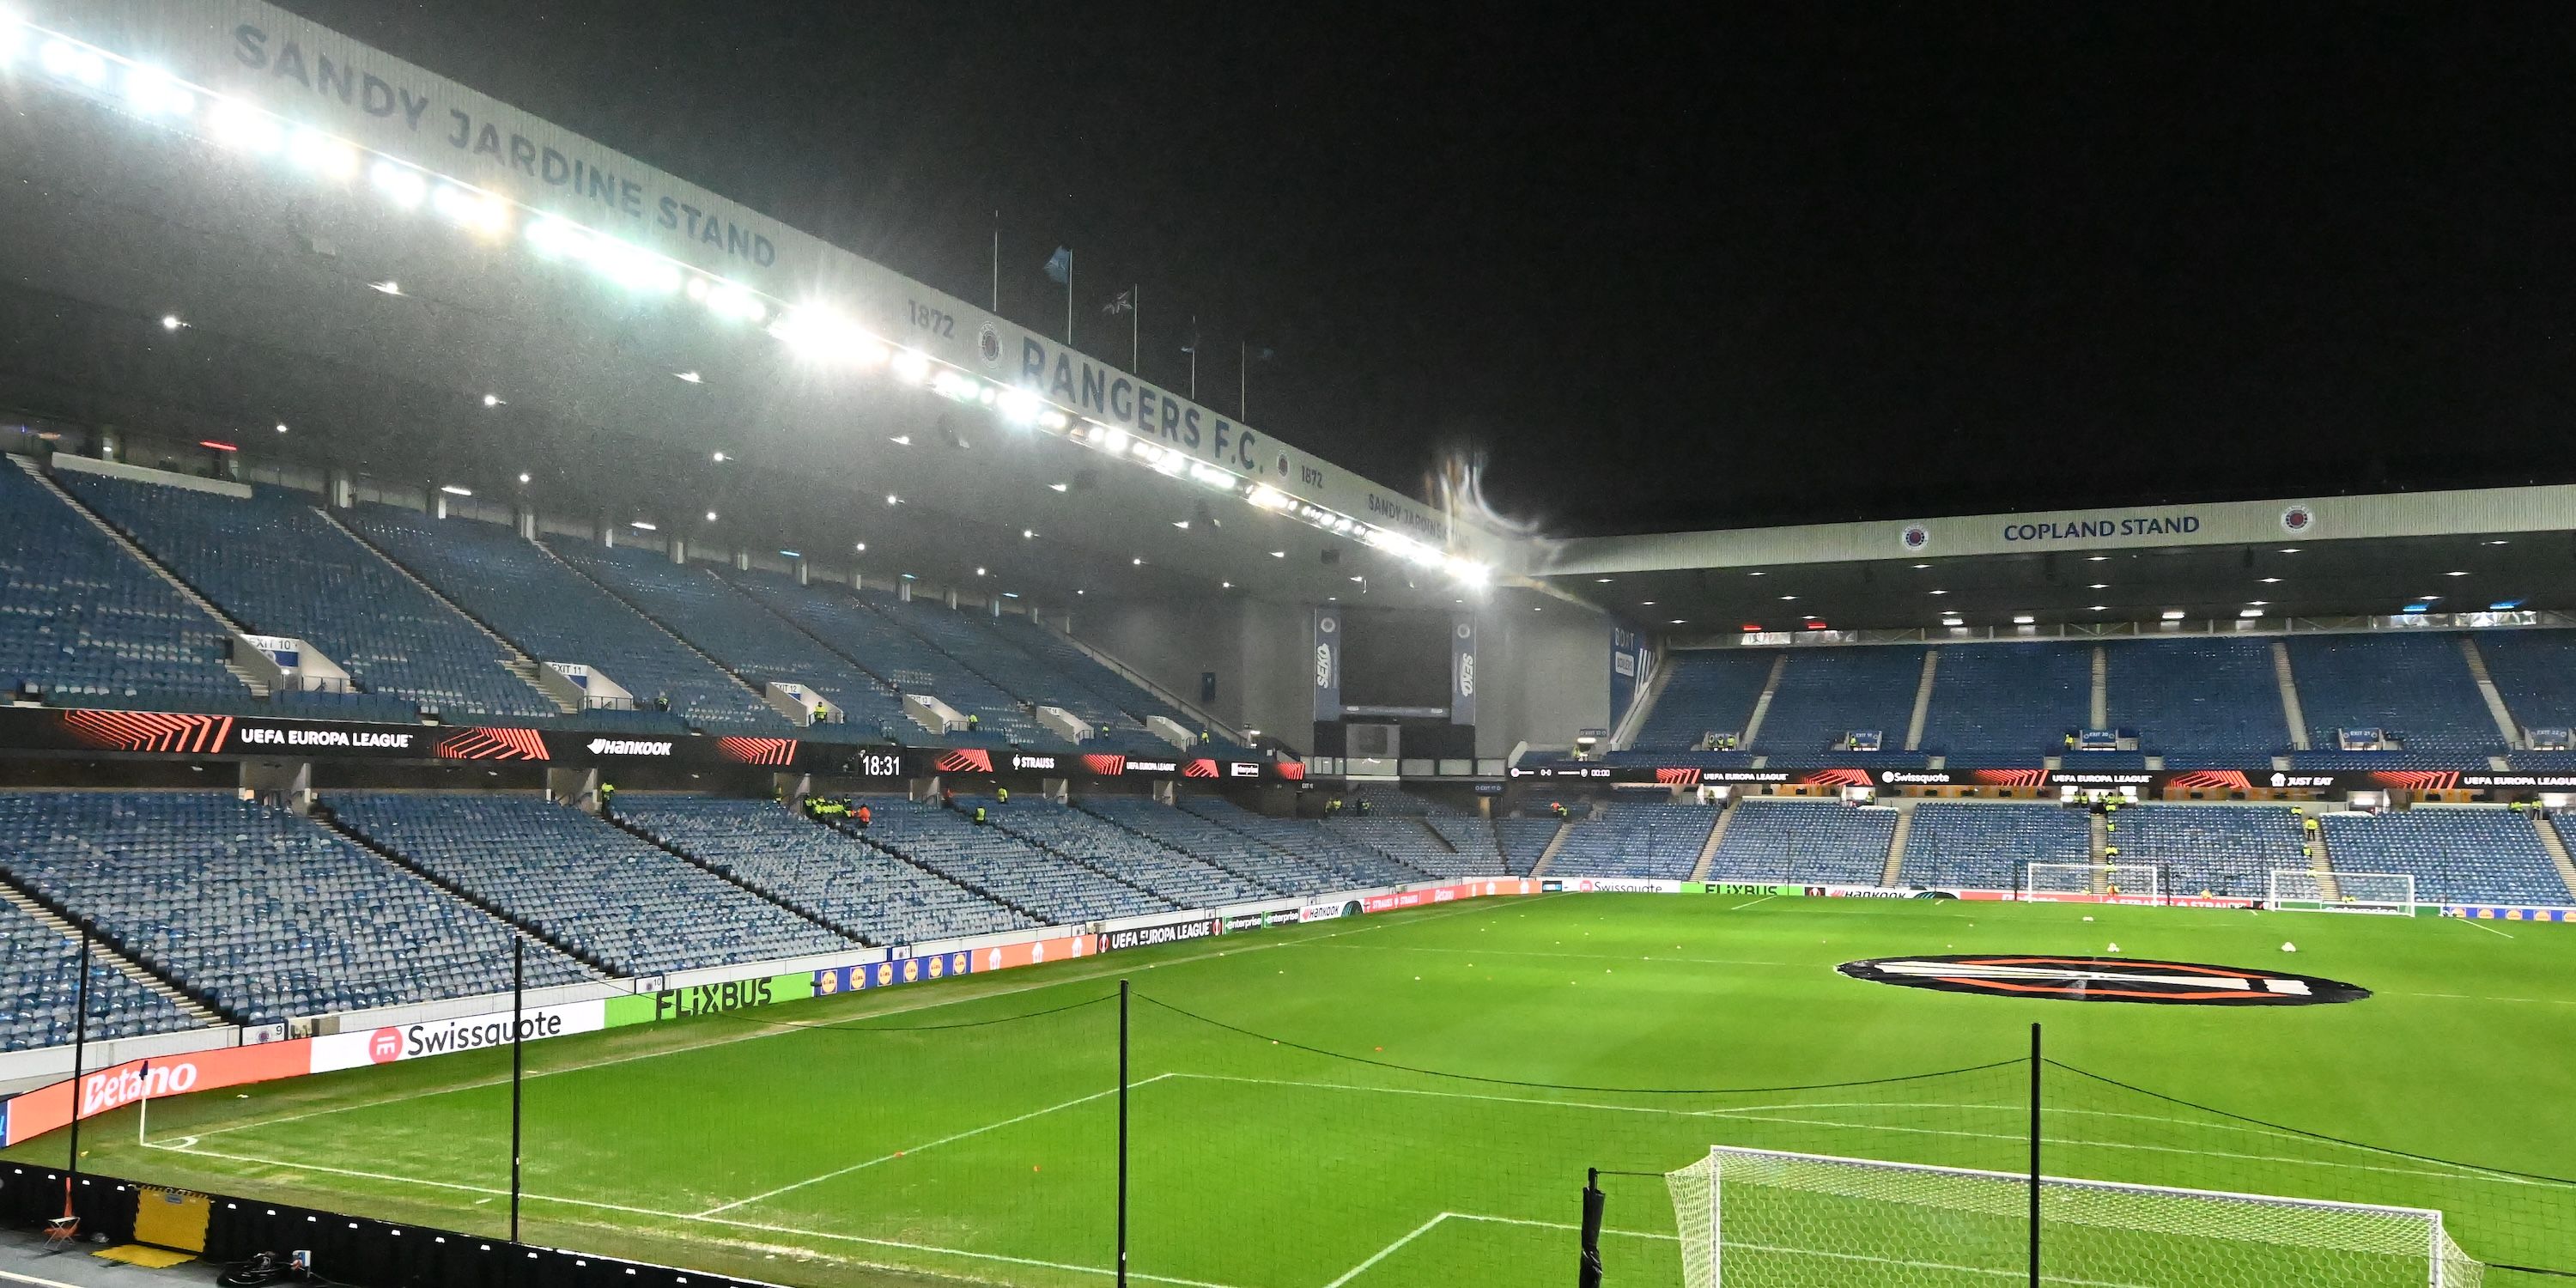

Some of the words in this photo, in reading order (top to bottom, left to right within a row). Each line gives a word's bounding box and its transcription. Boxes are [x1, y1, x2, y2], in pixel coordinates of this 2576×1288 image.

[233, 22, 428, 131] SANDY
[447, 107, 642, 218] JARDINE
[656, 196, 775, 268] STAND
[908, 299, 955, 340] 1872
[1019, 335, 1200, 449] RANGERS
[1215, 420, 1264, 475] F.C.
[1302, 465, 1323, 489] 1872
[1368, 493, 1401, 521] SANDY
[2004, 520, 2115, 541] COPLAND
[2121, 515, 2200, 537] STAND
[279, 640, 291, 650] 10
[1317, 643, 1332, 689] SEKO
[1461, 653, 1473, 697] SEKO
[241, 728, 283, 744] UEFA
[289, 730, 349, 746] EUROPA
[352, 732, 410, 749] LEAGUE
[862, 756, 900, 776] 18:31
[1021, 757, 1054, 769] STRAUSS
[1893, 773, 1949, 784] Swissquote
[2287, 777, 2312, 787] JUST
[2313, 777, 2335, 786] EAT
[1373, 898, 1393, 909] STRAUSS
[1228, 916, 1261, 930] enterprise
[1267, 911, 1298, 924] enterprise
[1112, 932, 1139, 950] UEFA
[1139, 927, 1176, 945] EUROPA
[1176, 921, 1211, 940] LEAGUE
[653, 977, 661, 986] 10
[276, 1025, 283, 1035] 9
[408, 1012, 561, 1056] Swissquote
[83, 1062, 197, 1115] Betano
